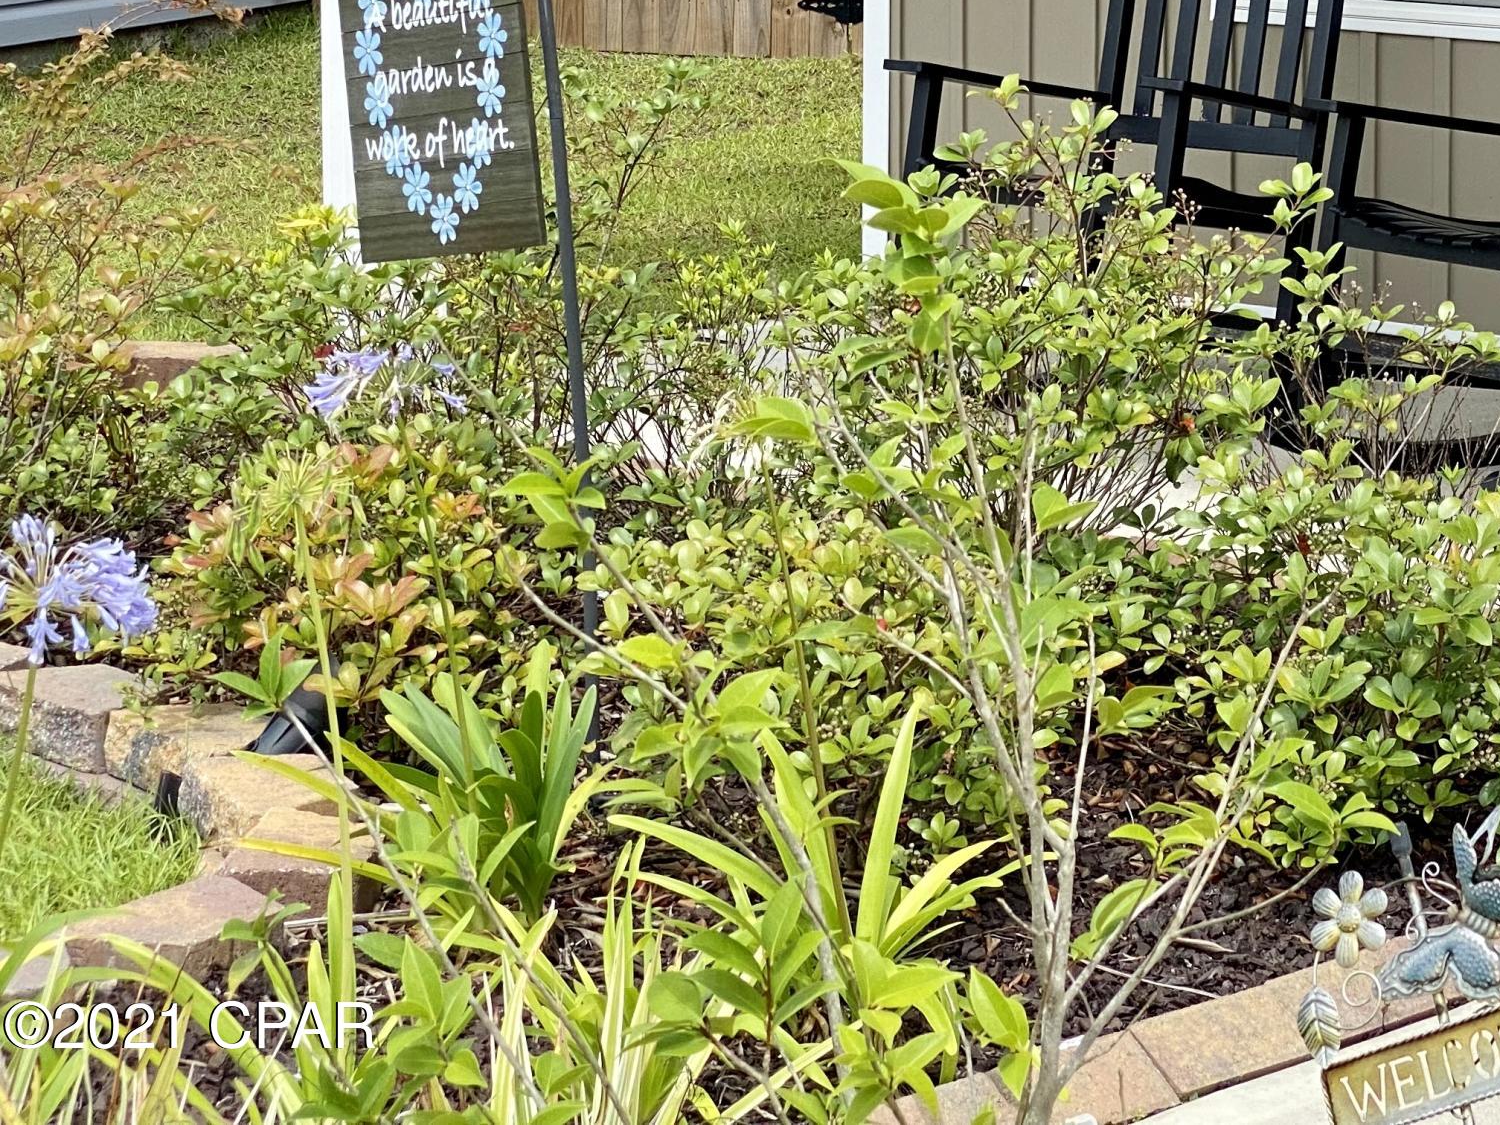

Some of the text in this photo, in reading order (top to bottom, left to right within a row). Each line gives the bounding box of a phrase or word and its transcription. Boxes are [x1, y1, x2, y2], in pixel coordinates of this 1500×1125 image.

[368, 3, 387, 33] A
[374, 48, 497, 107] garden is a
[366, 117, 515, 168] work of heart.
